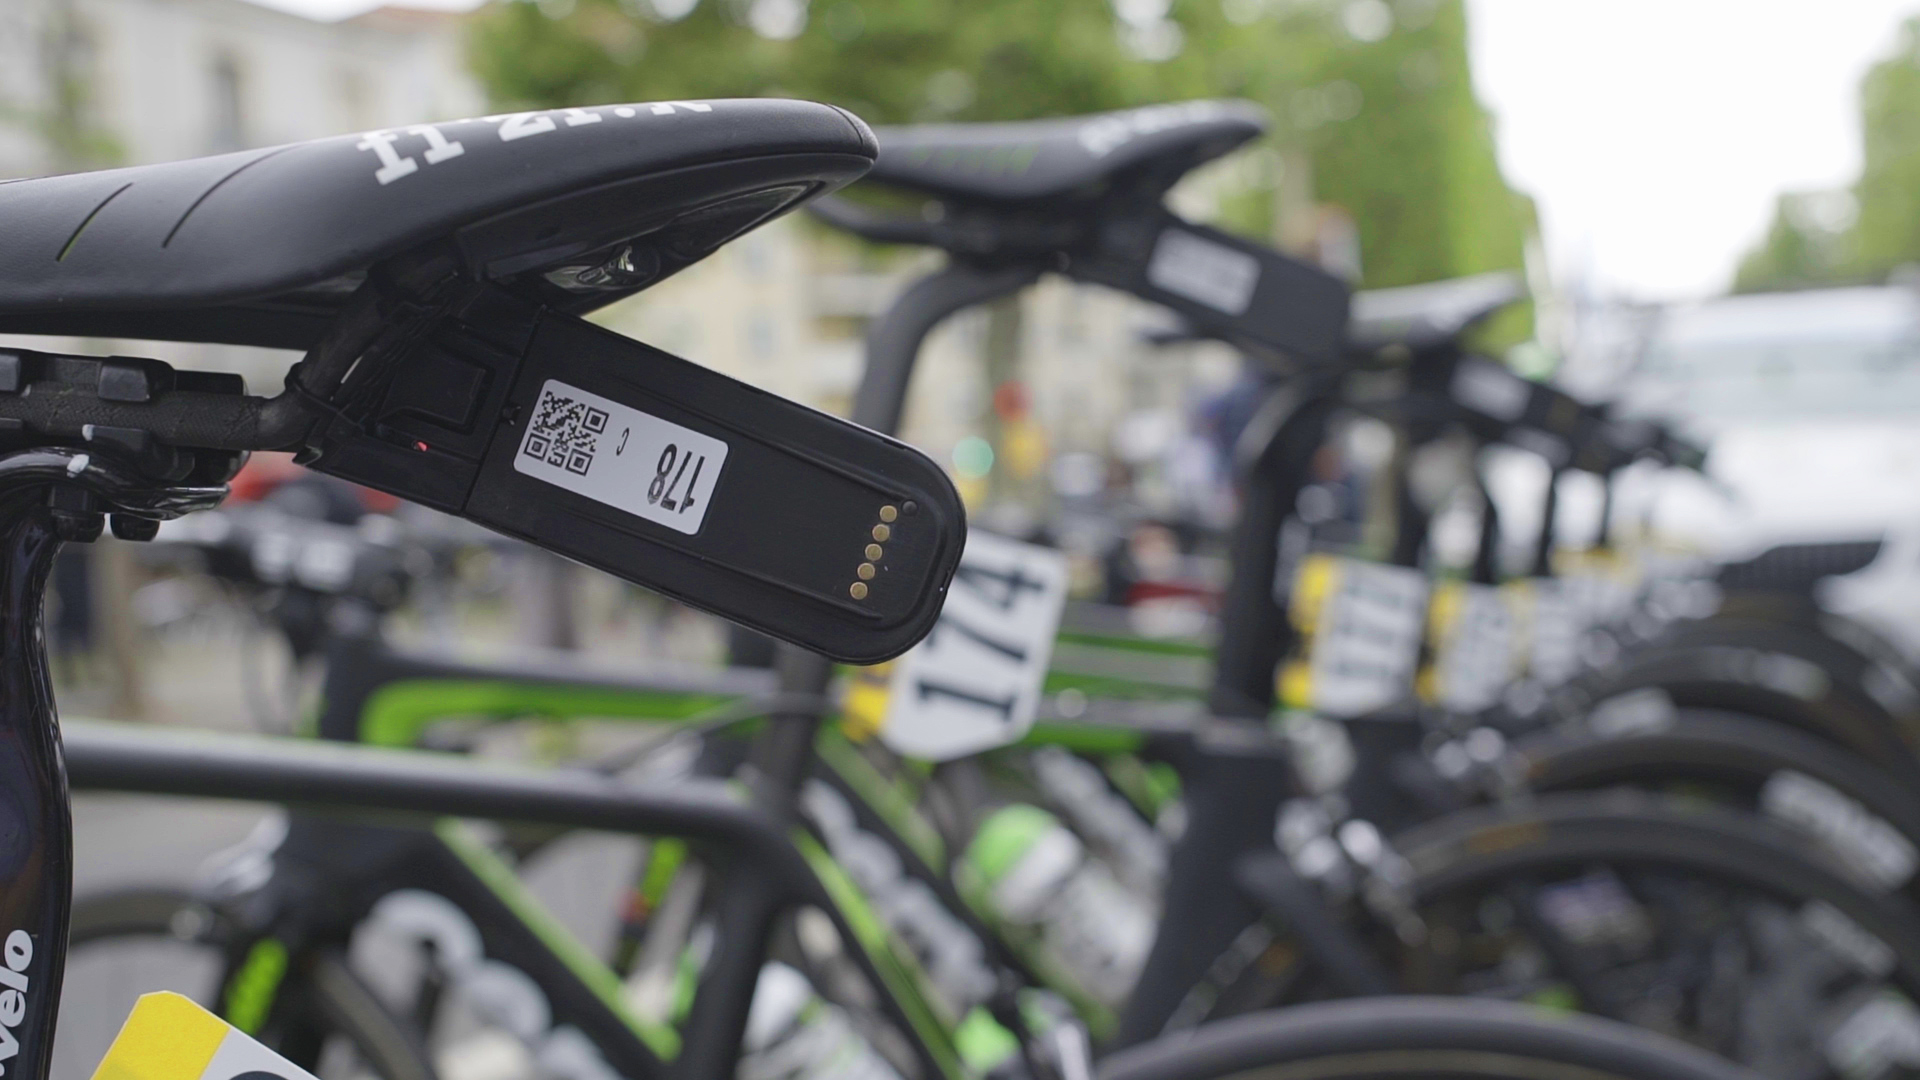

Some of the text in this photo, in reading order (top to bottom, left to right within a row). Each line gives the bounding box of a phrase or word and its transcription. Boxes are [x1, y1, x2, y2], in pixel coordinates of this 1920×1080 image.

[647, 443, 706, 515] 178
[915, 561, 1045, 723] 174
[0, 929, 34, 1077] velo
